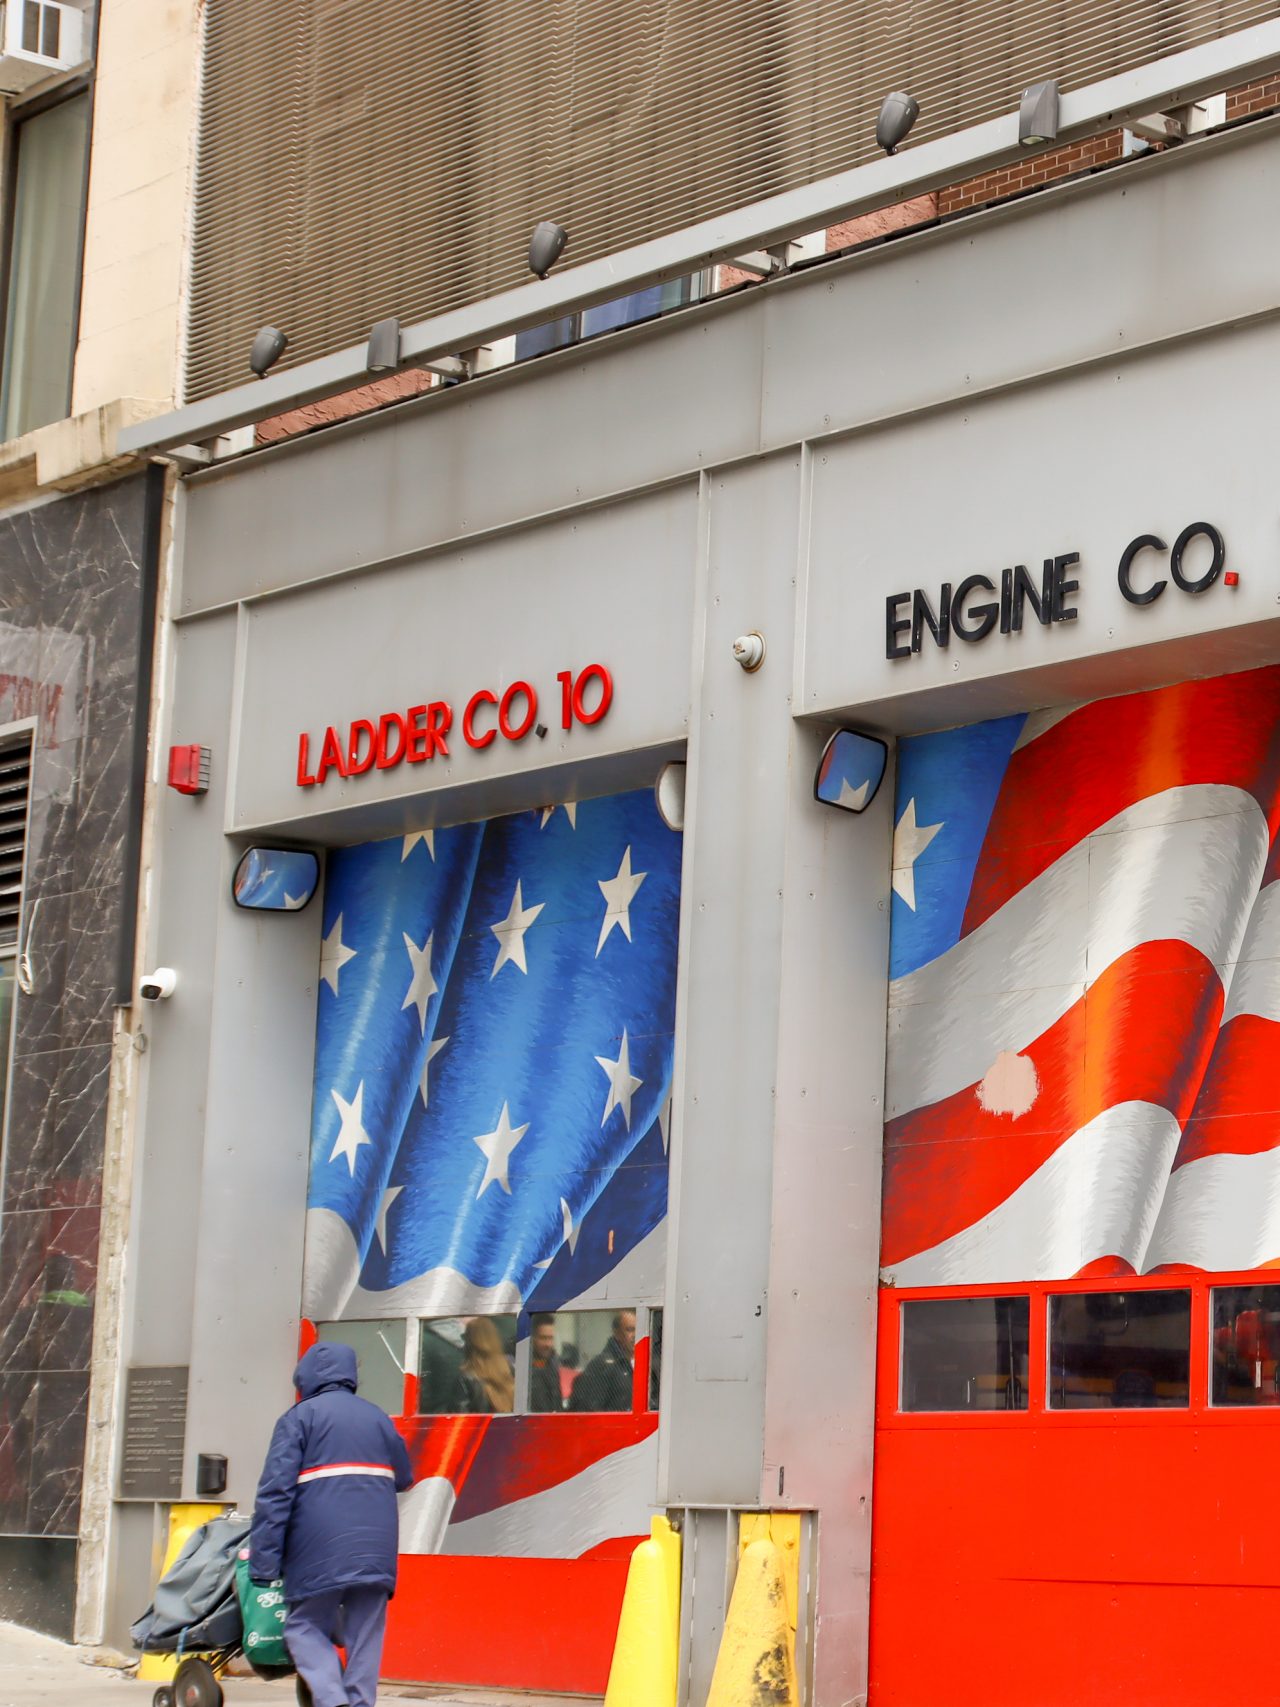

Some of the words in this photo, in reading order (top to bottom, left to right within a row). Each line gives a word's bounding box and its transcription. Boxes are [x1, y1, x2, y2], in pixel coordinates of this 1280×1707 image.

[886, 551, 1081, 660] ENGINE
[1118, 521, 1240, 606] CO.
[296, 701, 453, 787] LADDER
[462, 681, 548, 749] CO.
[557, 663, 613, 730] 10
